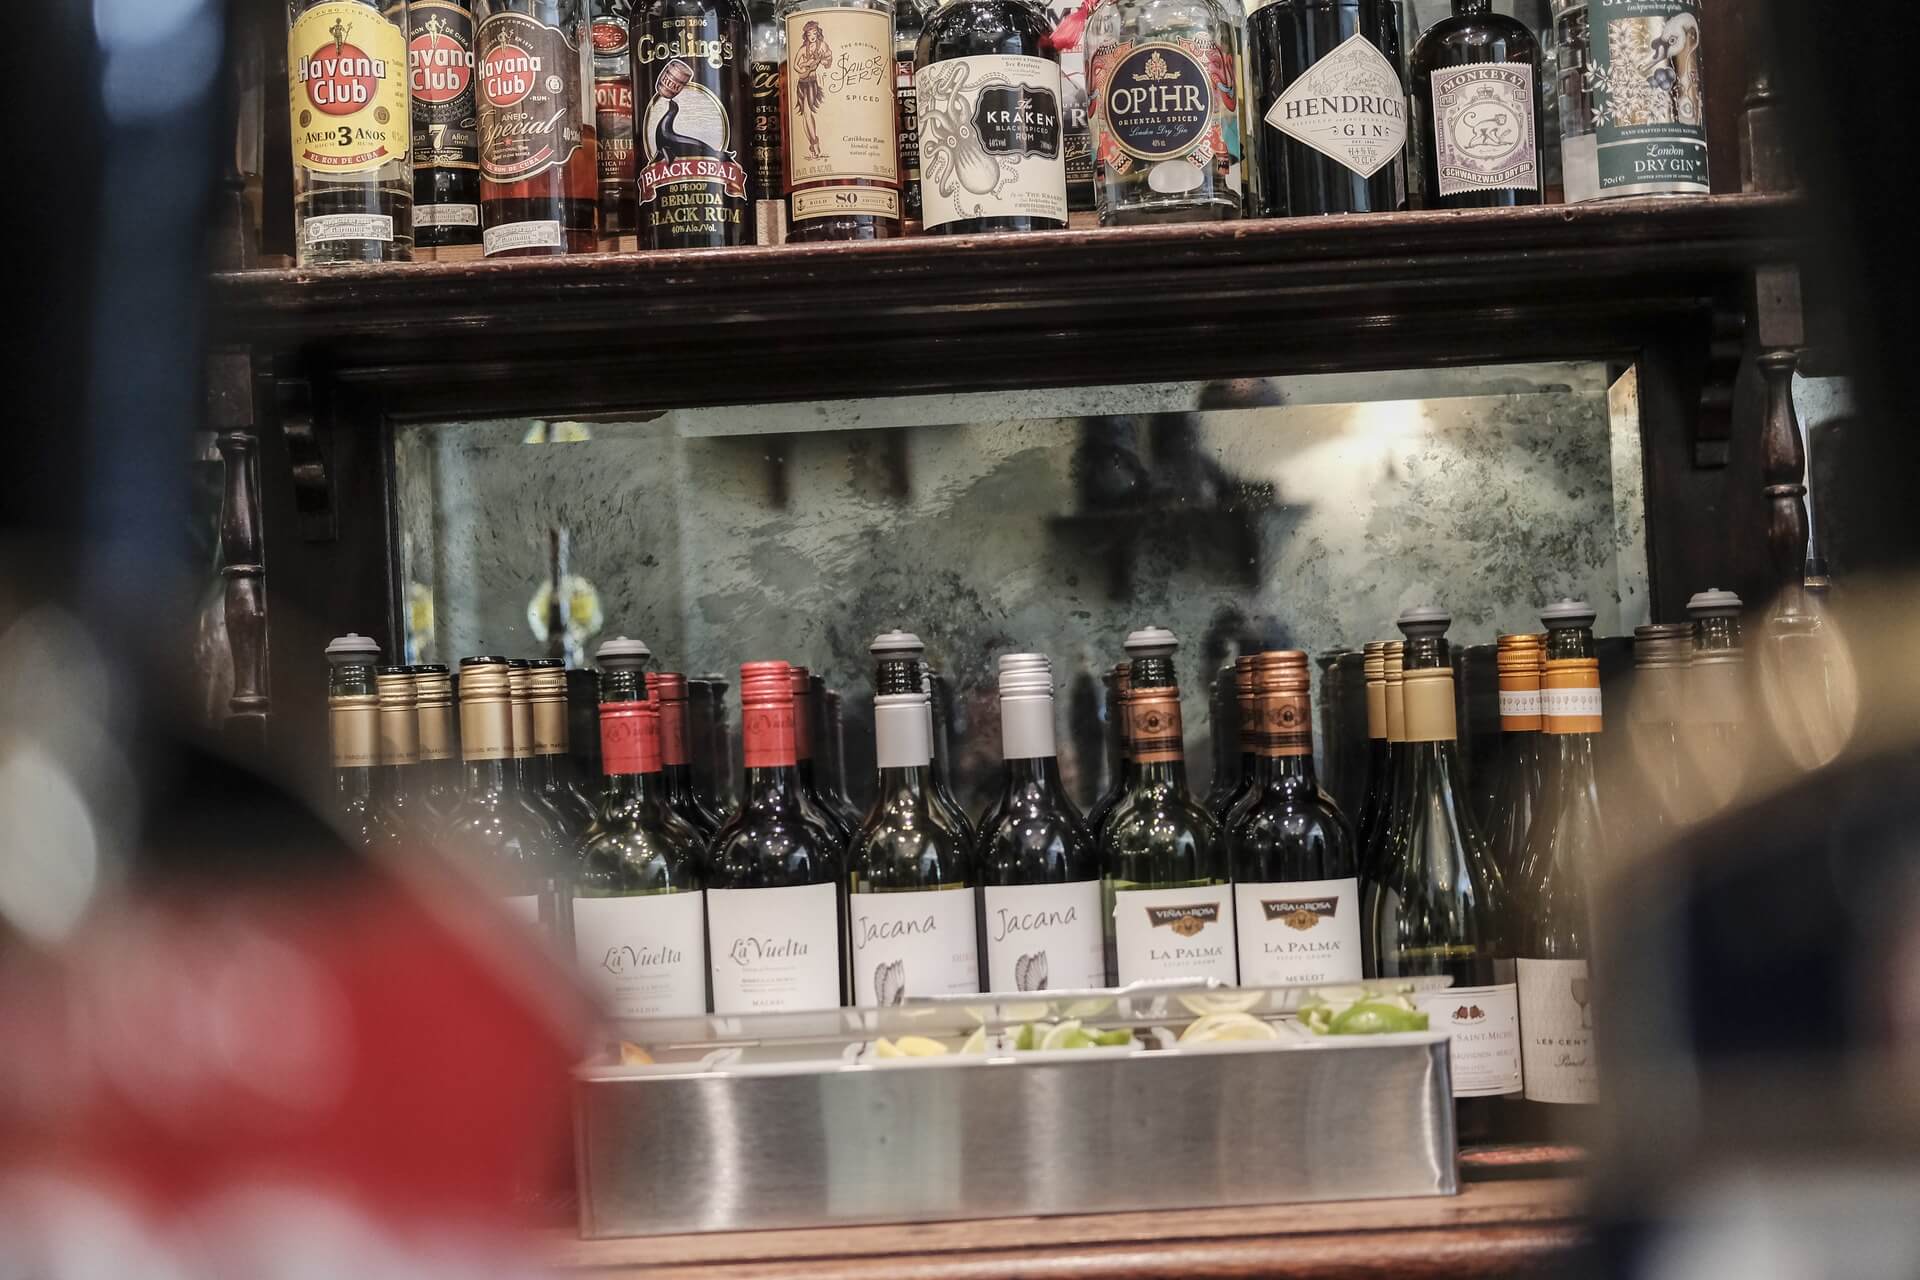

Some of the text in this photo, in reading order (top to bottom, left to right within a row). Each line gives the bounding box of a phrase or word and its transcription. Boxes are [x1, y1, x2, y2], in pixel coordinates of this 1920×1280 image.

[689, 19, 708, 27] 1806
[637, 28, 734, 69] Gosling's
[298, 55, 386, 83] Havana
[409, 49, 474, 69] avana
[478, 56, 542, 80] Havana
[411, 67, 460, 90] Club
[488, 75, 526, 97] Club
[661, 74, 681, 92] RUM
[1443, 69, 1524, 92] MONKEY 47
[314, 79, 368, 105] Club
[846, 94, 880, 103] SPICED
[1111, 84, 1206, 115] OPIHR
[1015, 97, 1033, 110] The
[1285, 95, 1405, 120] HENDRICK
[986, 111, 1054, 127] KRAKEN
[1118, 115, 1198, 126] ORIENTAL SPICED
[338, 126, 352, 146] 3
[429, 124, 447, 150] 7
[480, 108, 567, 156] Especial
[1015, 133, 1034, 141] RUM
[1343, 124, 1383, 136] GIN
[355, 151, 378, 163] CUBA
[1646, 143, 1684, 157] London
[519, 158, 539, 168] CUBA
[1446, 162, 1530, 183] SCHWARZWALD DRY GIN
[1634, 158, 1695, 172] DRY GIN
[644, 162, 692, 187] BLACK
[697, 162, 737, 180] SEAL
[661, 193, 723, 207] BERMUDA
[835, 192, 858, 205] 80
[649, 207, 741, 226] BLACK RUM
[857, 915, 936, 950] Jacana
[993, 906, 1078, 942] Jacana
[729, 937, 808, 966] La Vuelta
[1150, 946, 1222, 960] LA PALMA
[1264, 941, 1340, 953] LA PALMA
[603, 945, 681, 975] La Vuelta
